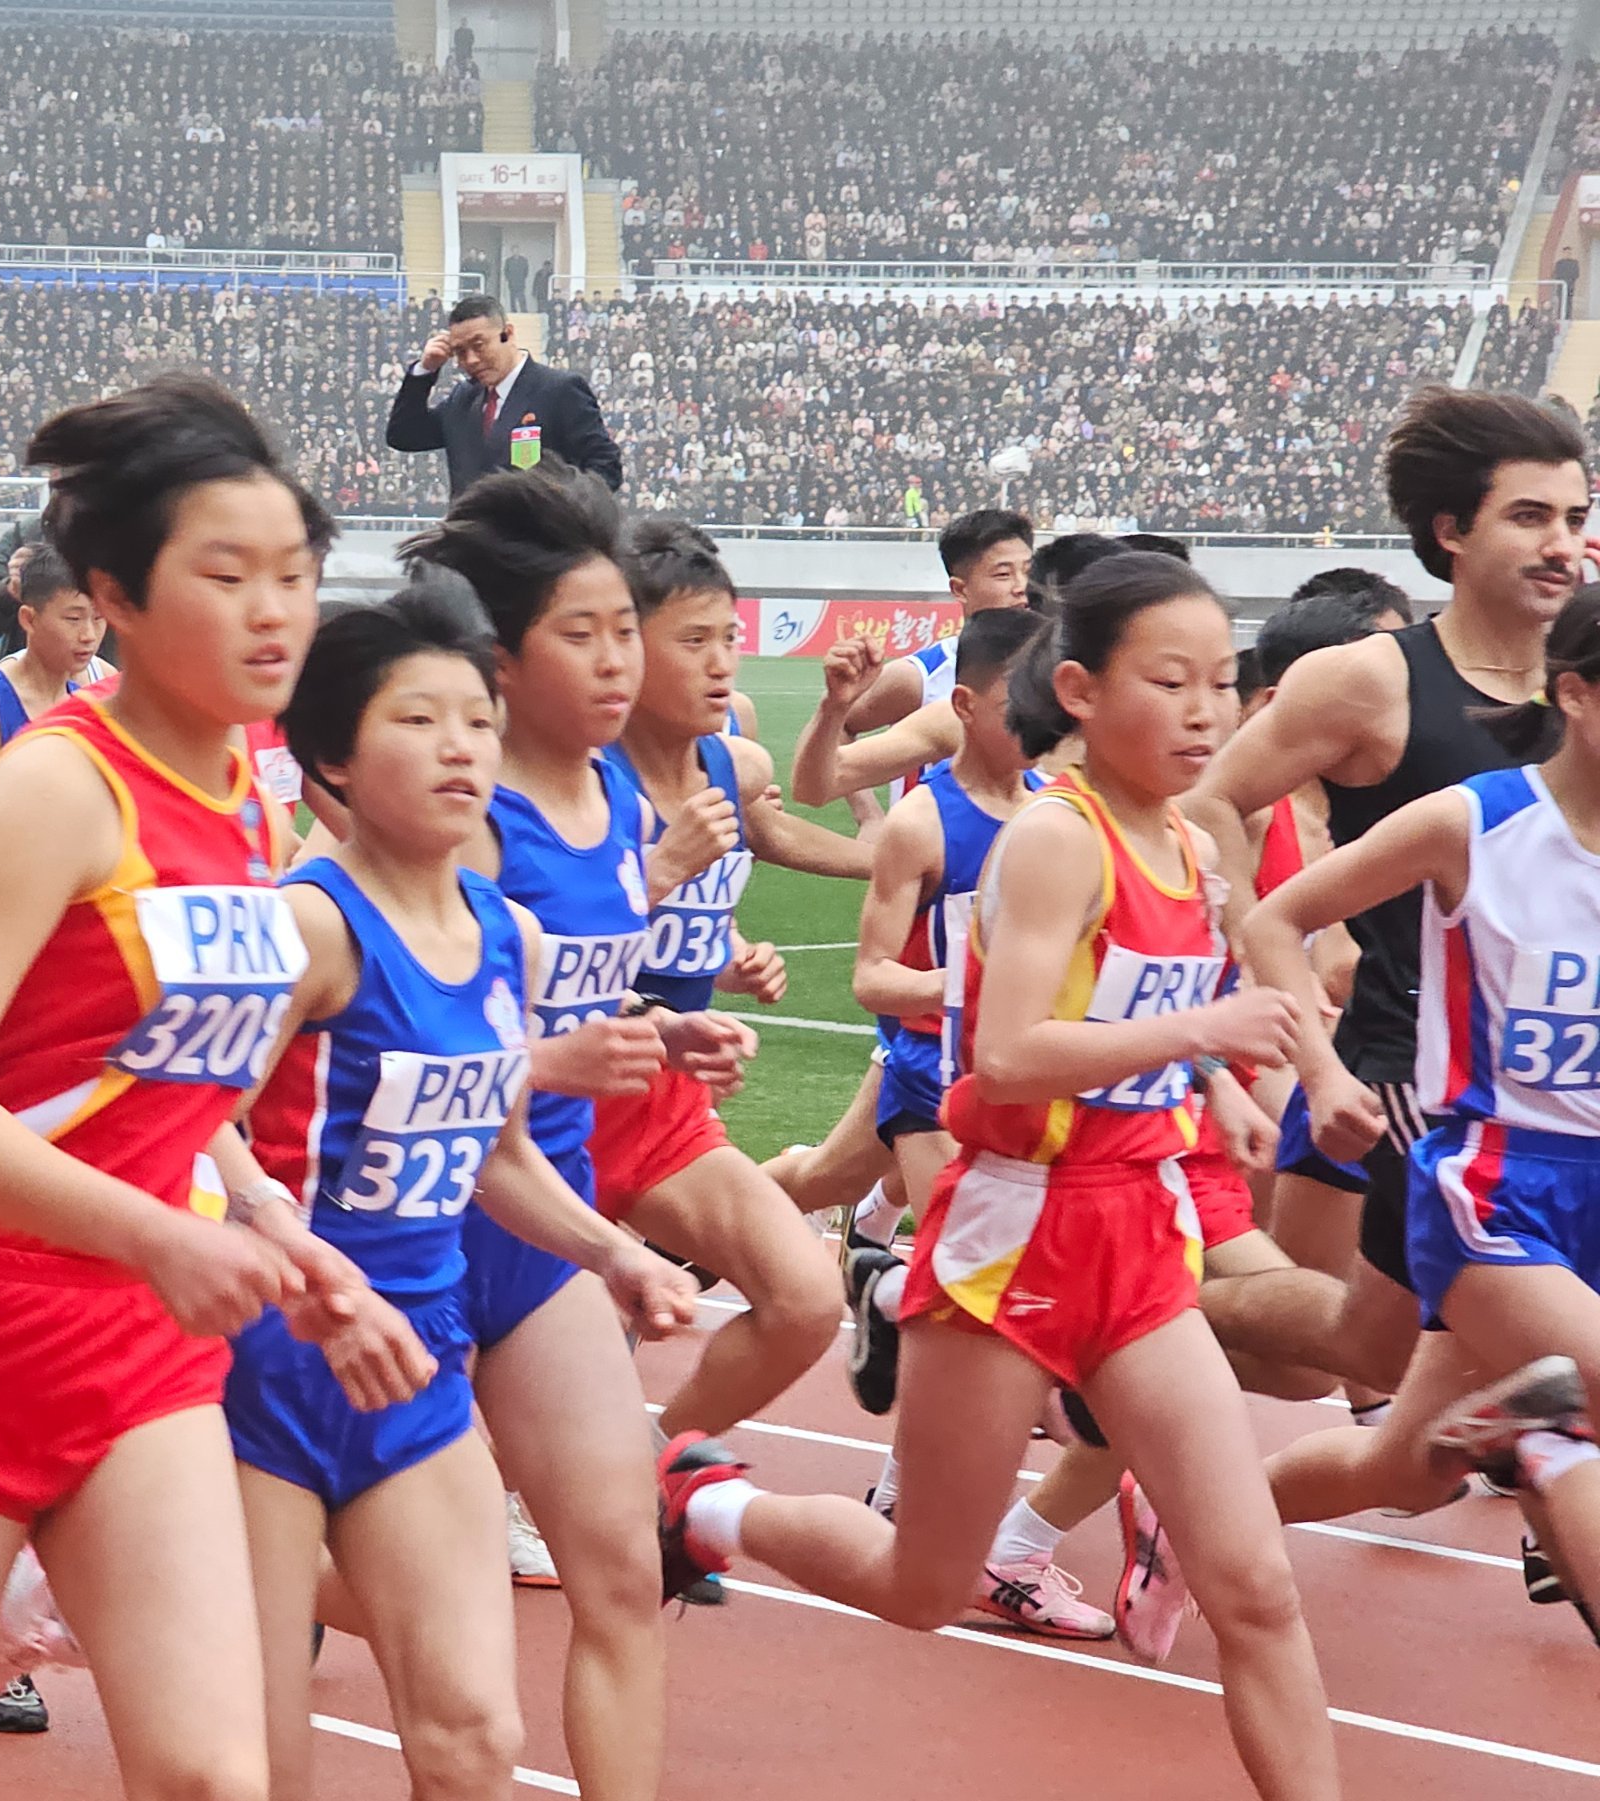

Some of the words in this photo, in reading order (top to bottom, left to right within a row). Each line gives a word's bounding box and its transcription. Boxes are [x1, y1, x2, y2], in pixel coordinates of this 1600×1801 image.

[490, 164, 528, 185] 16-1
[184, 894, 290, 975] PRK
[543, 936, 645, 1000] PRK
[1122, 962, 1223, 1020] PRK
[1504, 1018, 1600, 1085] 32
[404, 1056, 522, 1125] PRK
[340, 1136, 496, 1218] 323
